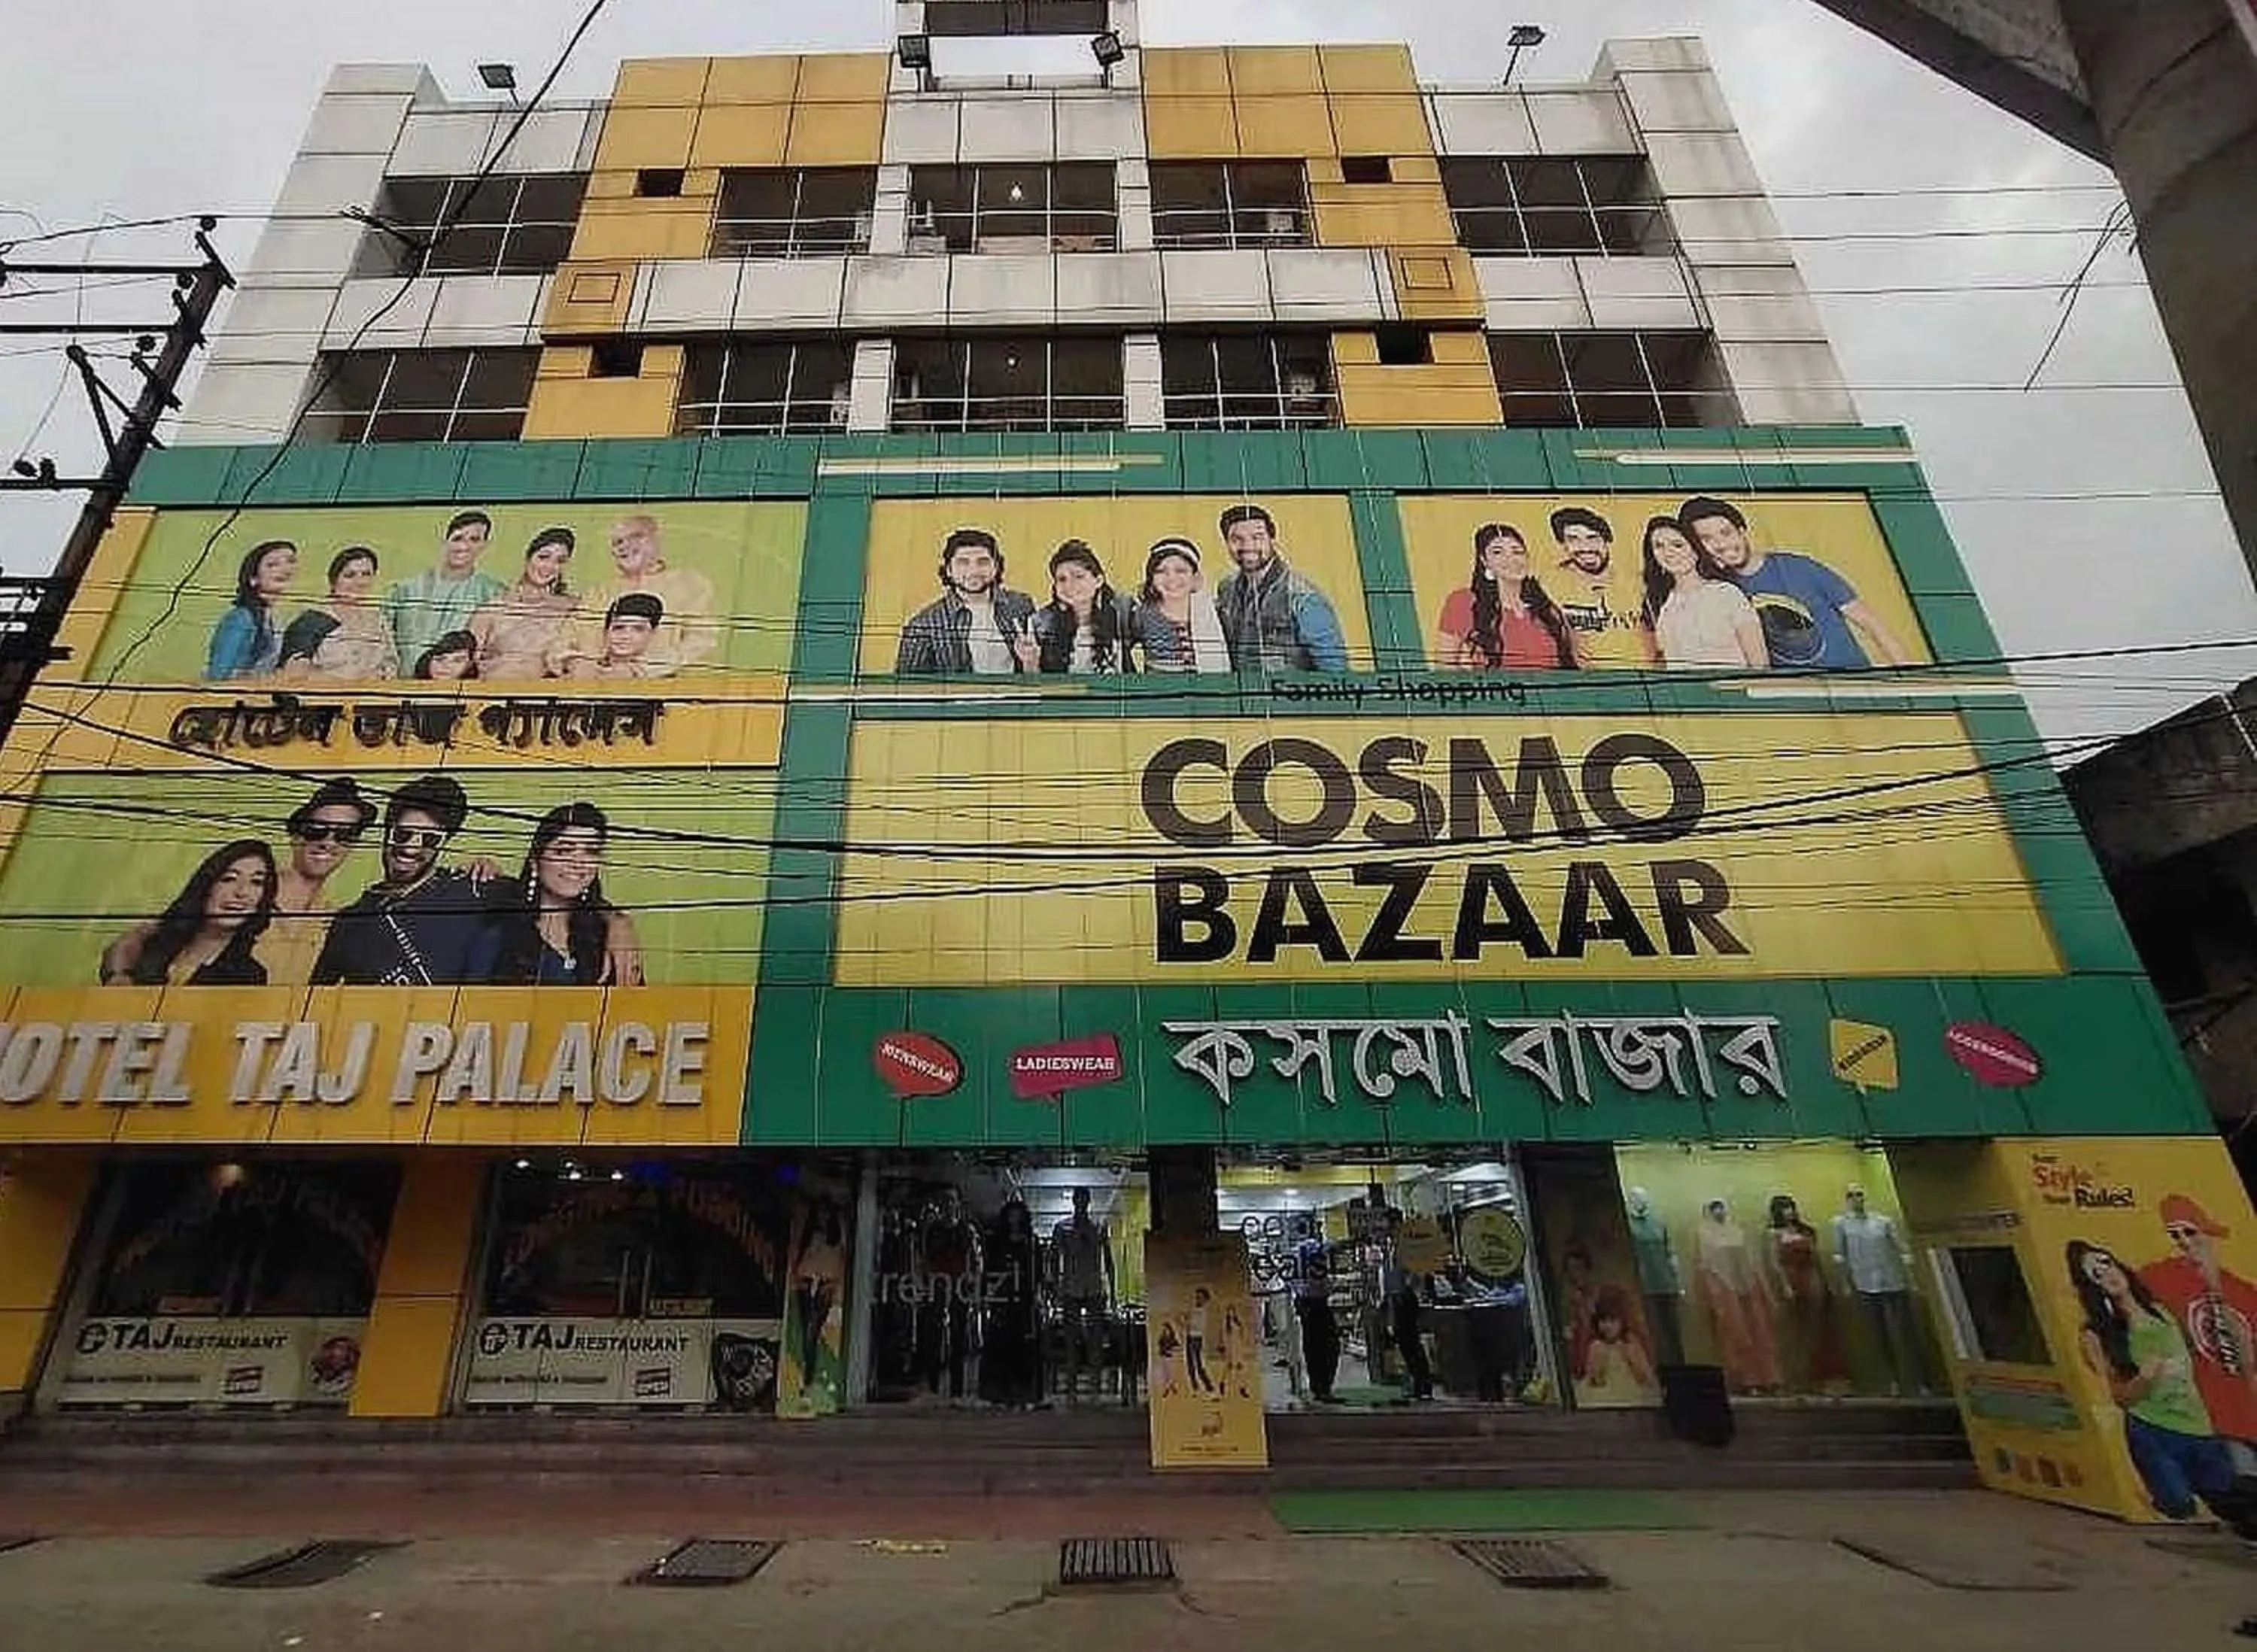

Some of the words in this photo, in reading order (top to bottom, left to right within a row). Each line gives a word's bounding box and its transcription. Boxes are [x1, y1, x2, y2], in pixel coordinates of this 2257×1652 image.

[1271, 679, 1364, 709] Family
[1377, 672, 1525, 708] Shopping
[1141, 734, 1706, 848] COSMO
[1153, 859, 1751, 964] BAZAAR
[0, 1022, 193, 1104] OTEL
[229, 1022, 378, 1104] TAJ
[390, 1021, 711, 1105] PALACE
[1016, 1056, 1116, 1071] LADIESWEAR
[1161, 1008, 1473, 1104] কসমো
[1485, 1007, 1788, 1104] বাজার
[111, 1324, 175, 1350] TAJ
[513, 1323, 576, 1350] TAJ
[575, 1336, 691, 1352] RESTAURANT
